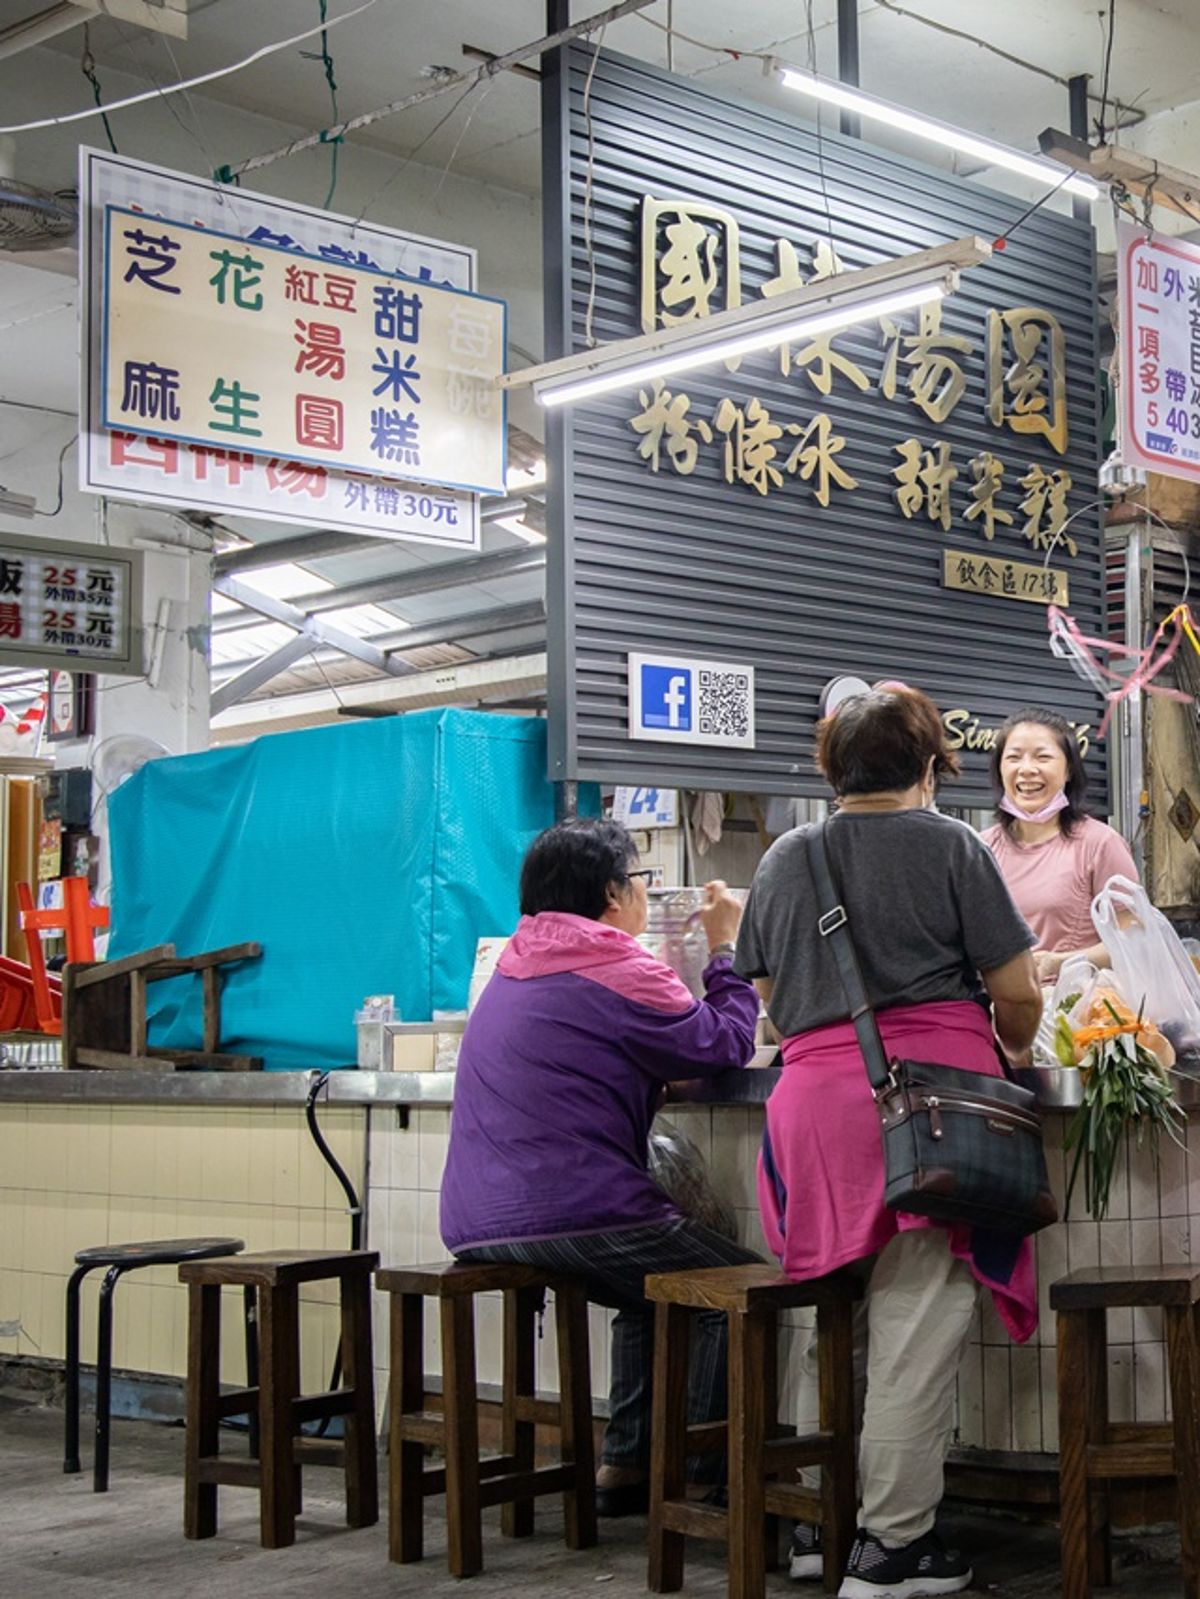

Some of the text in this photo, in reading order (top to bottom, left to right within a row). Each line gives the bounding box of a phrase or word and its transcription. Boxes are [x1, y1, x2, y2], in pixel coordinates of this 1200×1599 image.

[121, 229, 181, 421] 芝麻
[208, 250, 264, 438] 花生
[285, 265, 357, 313] 紅豆
[370, 286, 423, 466] 甜米糕
[344, 482, 458, 525] 外帶30元
[943, 709, 998, 751] Sin
